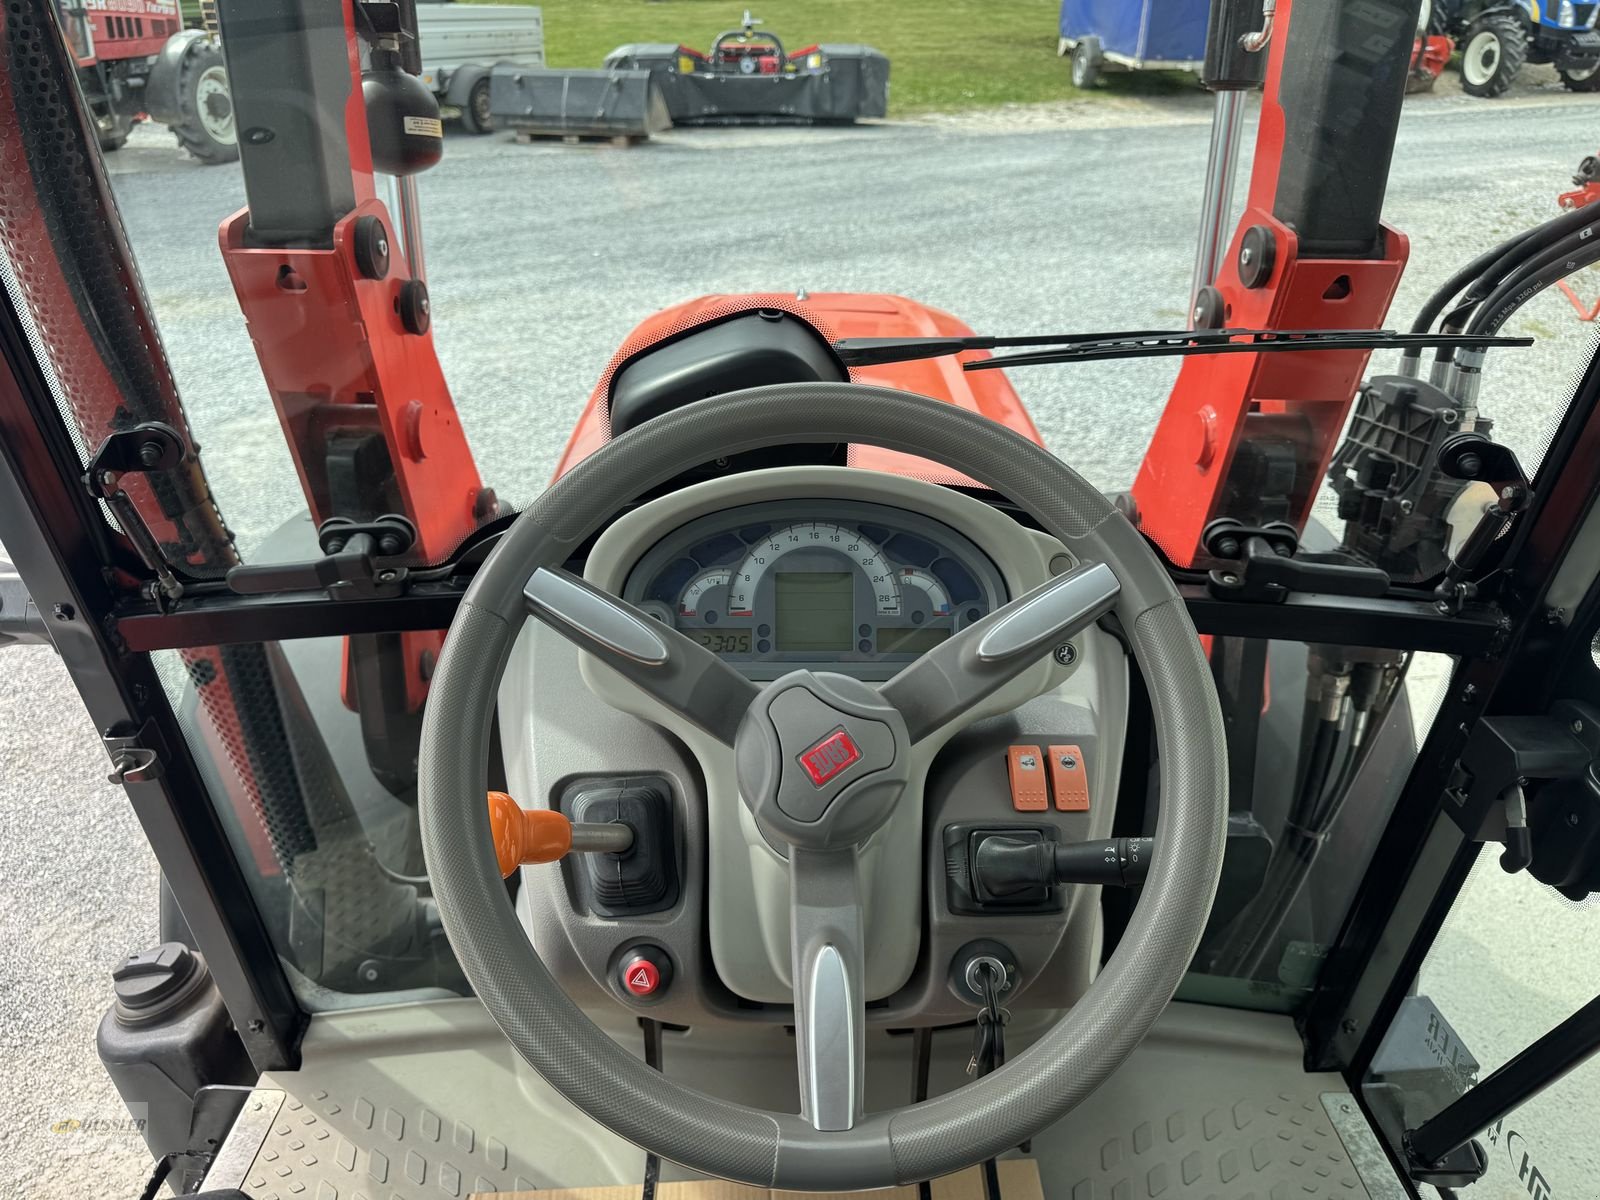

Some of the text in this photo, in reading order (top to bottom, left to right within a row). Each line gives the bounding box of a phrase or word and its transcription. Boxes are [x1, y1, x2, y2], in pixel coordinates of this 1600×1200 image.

[1515, 287, 1533, 301] 3260
[1532, 280, 1543, 292] psi
[809, 532, 820, 540] 16
[769, 543, 780, 551] 12
[847, 544, 859, 552] 20
[754, 557, 765, 565] 10
[862, 558, 874, 566] 22
[744, 574, 751, 582] 8
[873, 575, 884, 583] 24
[738, 594, 745, 602] 6
[878, 594, 890, 602] 26
[809, 738, 849, 778] SAME
